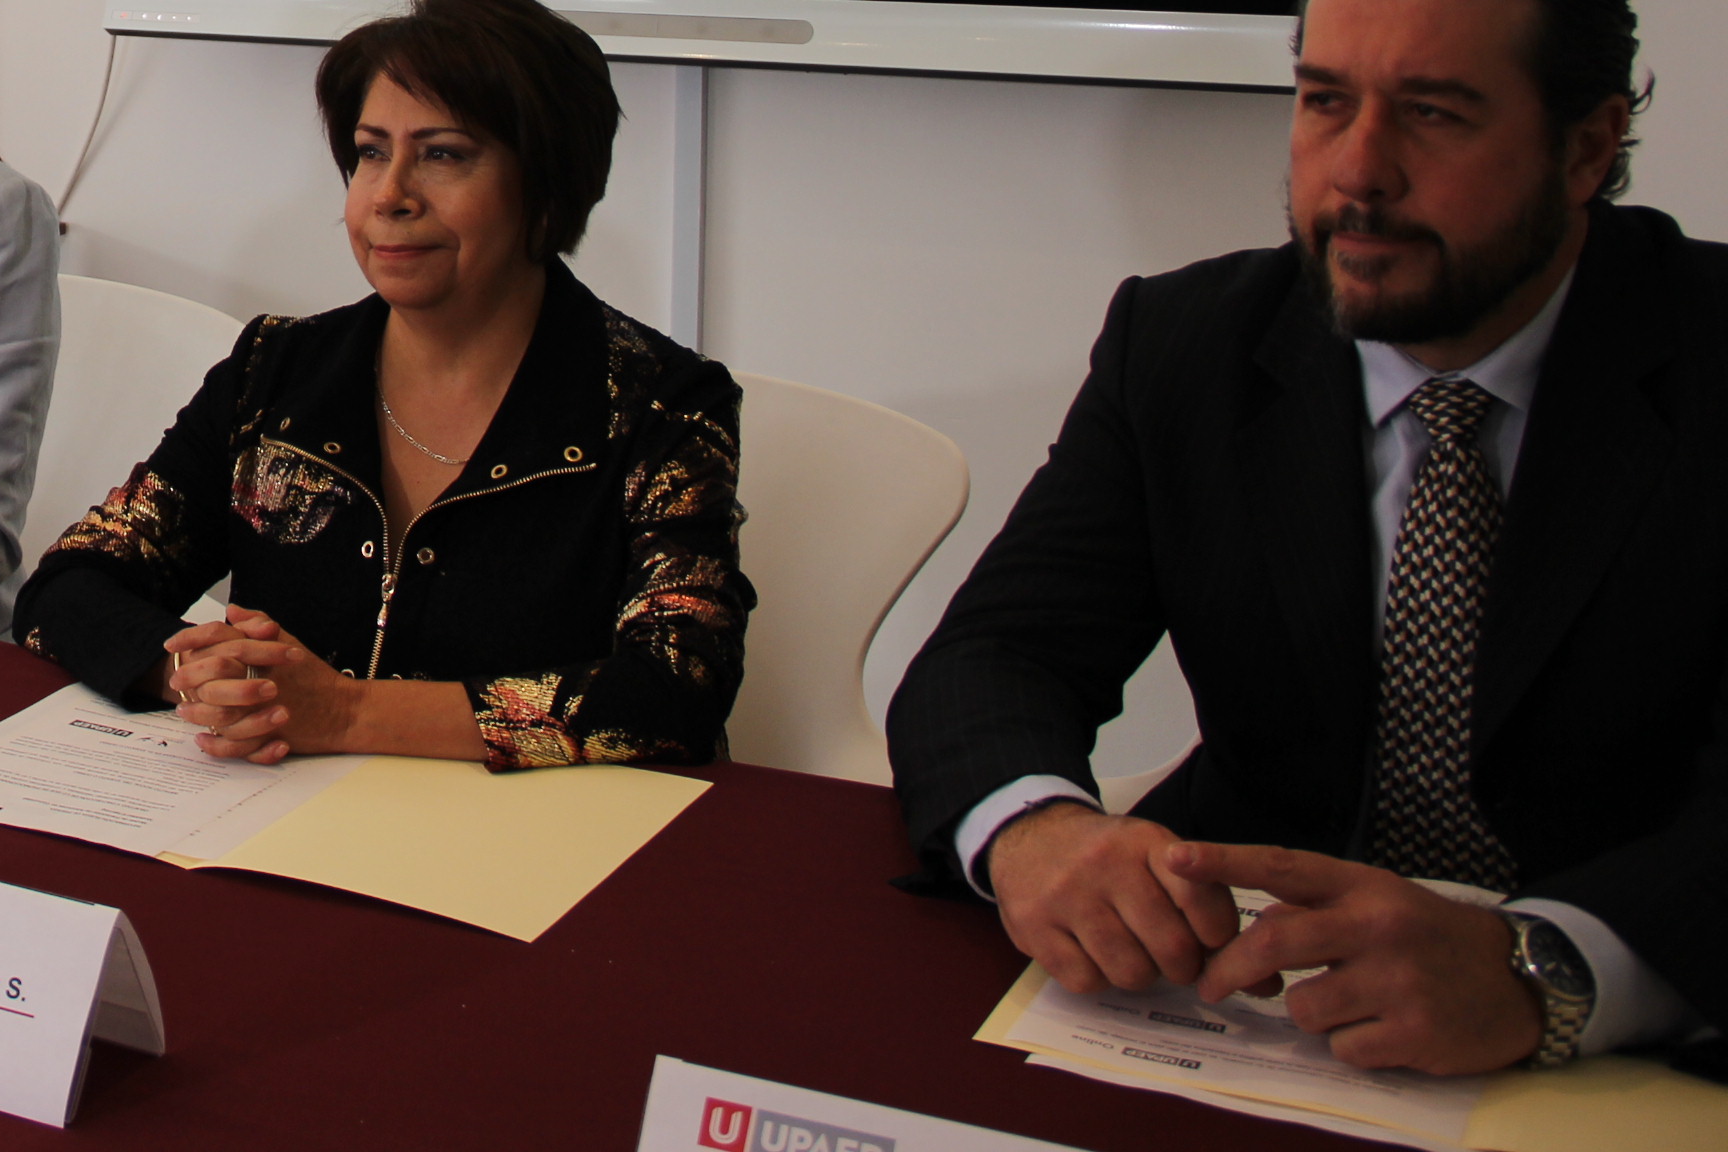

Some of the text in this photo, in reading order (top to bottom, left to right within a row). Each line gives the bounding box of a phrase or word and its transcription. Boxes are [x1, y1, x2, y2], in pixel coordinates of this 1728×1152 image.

[5, 977, 28, 1002] S.
[1072, 1034, 1115, 1050] Online
[1125, 1049, 1178, 1066] UPAEP
